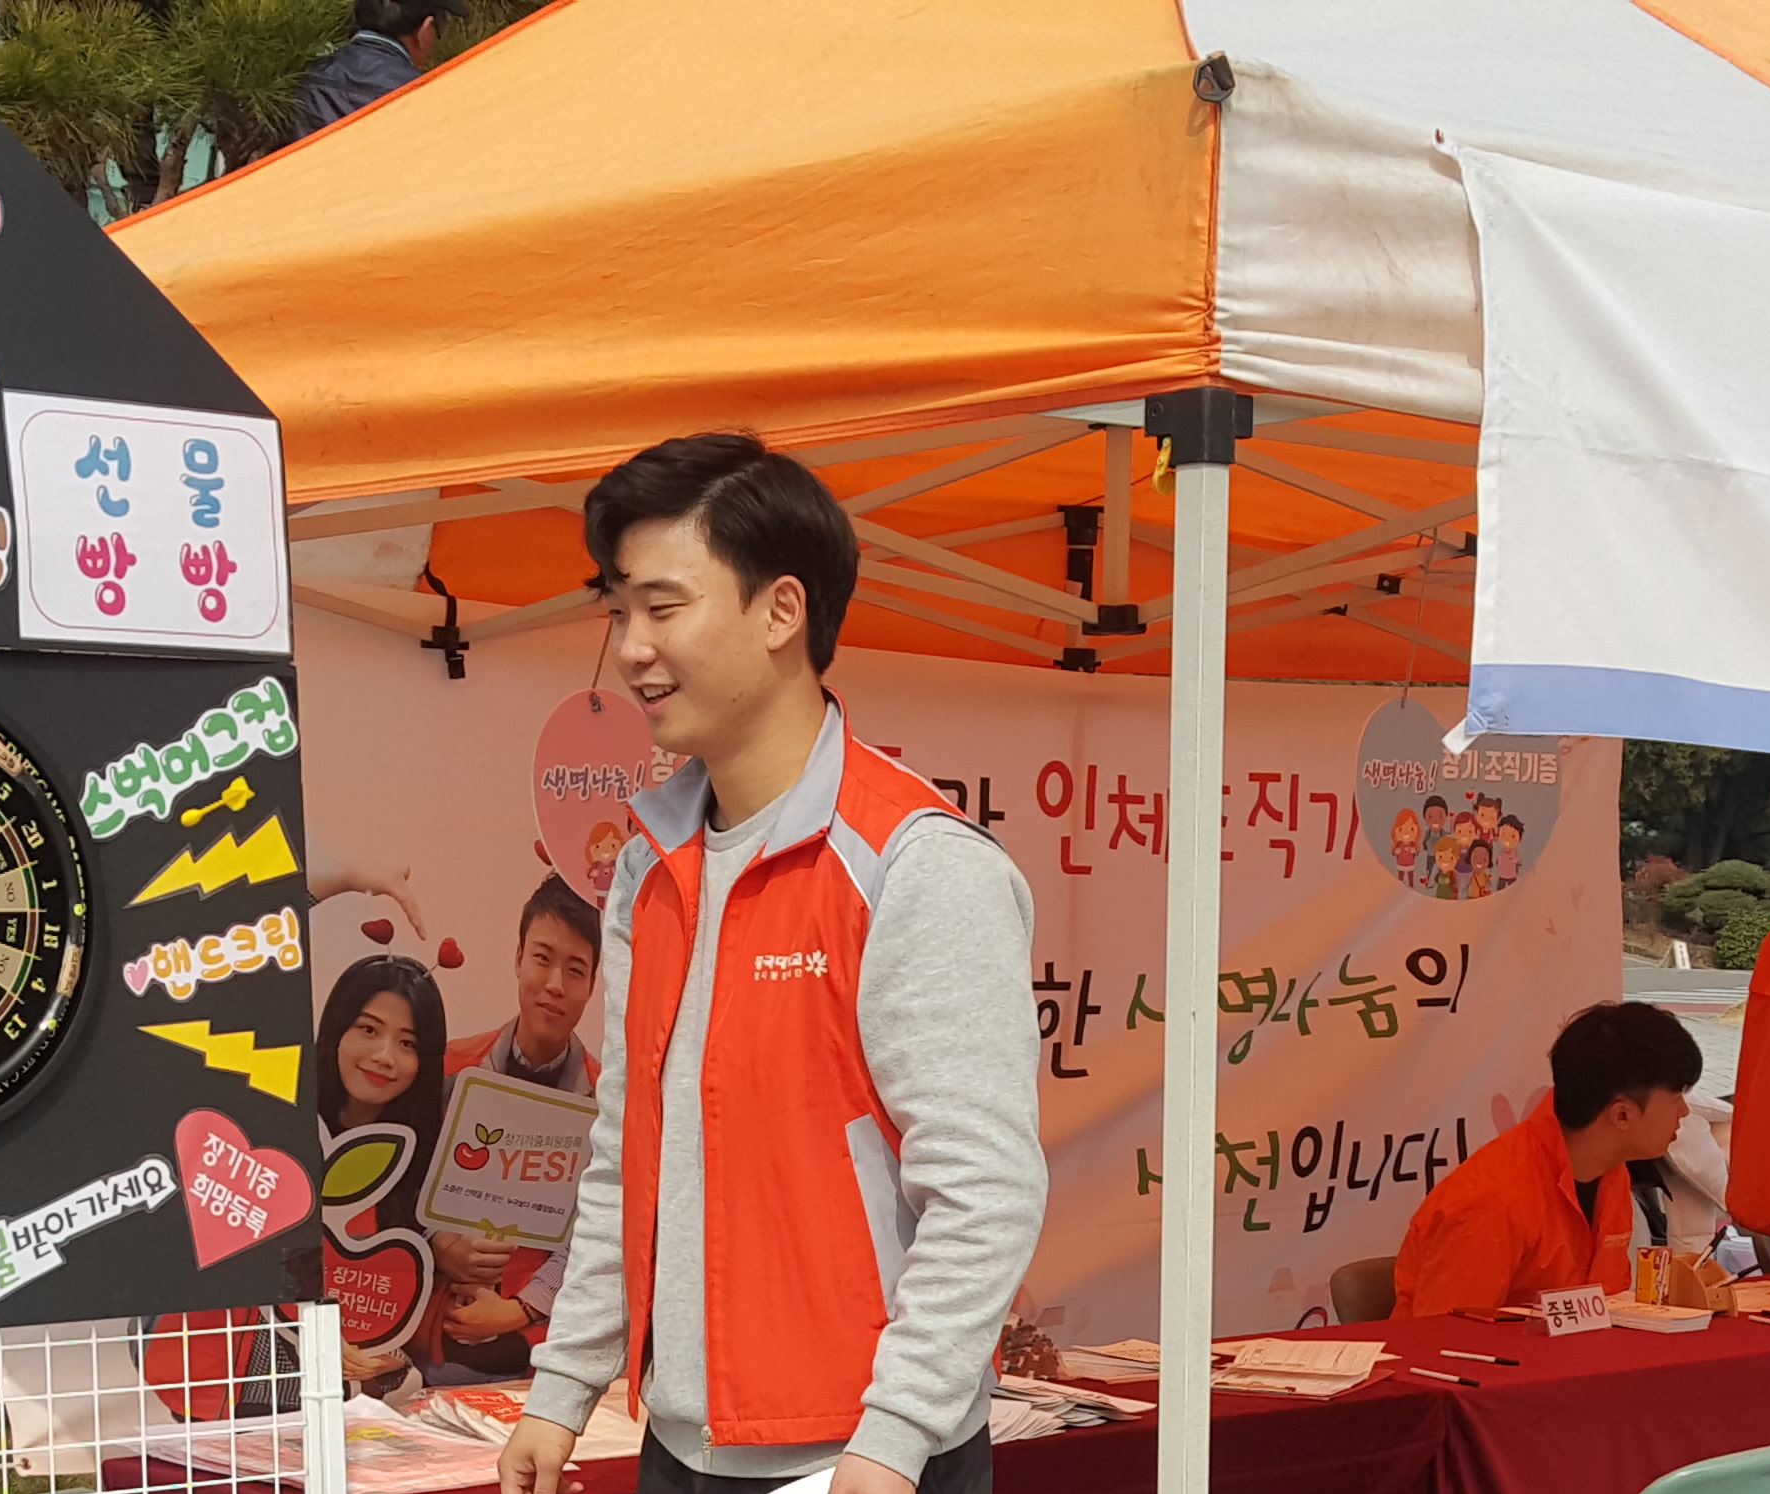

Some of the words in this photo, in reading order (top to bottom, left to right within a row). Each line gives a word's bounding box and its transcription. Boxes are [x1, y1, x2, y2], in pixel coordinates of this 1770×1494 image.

[542, 760, 644, 802] 생명나눔!
[1362, 758, 1438, 795] 생명나눔!
[1035, 759, 1359, 878] 인체직기
[20, 819, 45, 850] 20
[5, 882, 15, 903] NO
[42, 878, 58, 891] 1
[6, 917, 17, 943] YES
[42, 921, 61, 949] 18
[152, 909, 302, 998] 핸드크림
[31, 978, 48, 993] 4
[2, 1014, 27, 1039] 13
[202, 1132, 279, 1199] 장기기증
[499, 1149, 579, 1182] YES!
[190, 1172, 268, 1239] 희망등록
[333, 1266, 392, 1295] 장기기증
